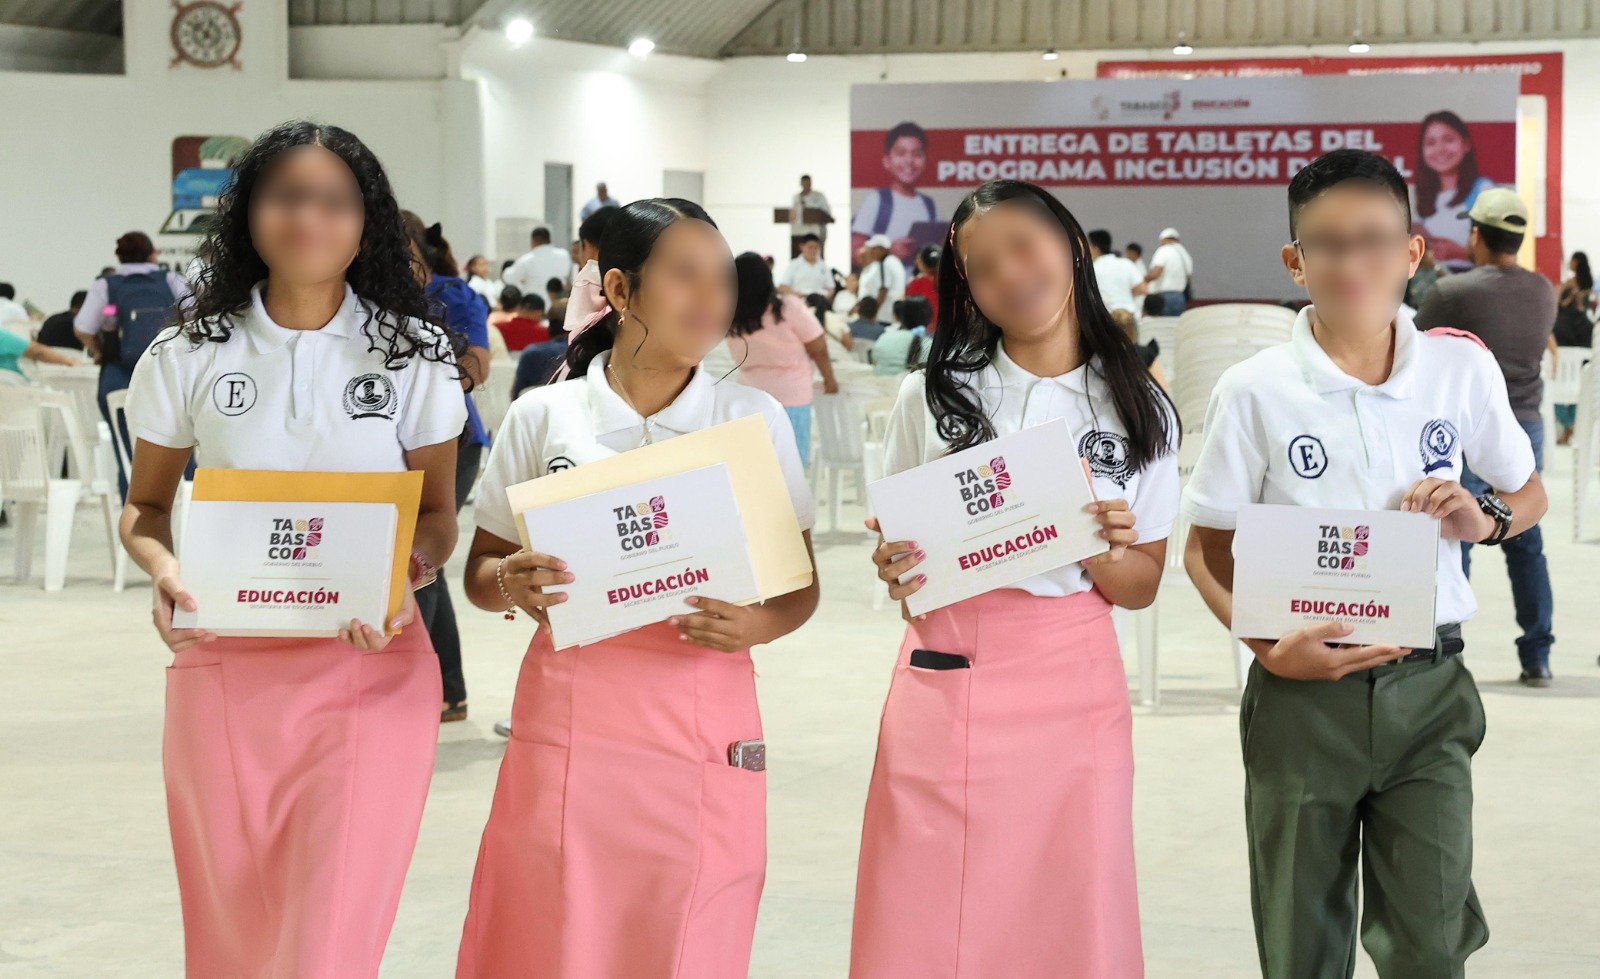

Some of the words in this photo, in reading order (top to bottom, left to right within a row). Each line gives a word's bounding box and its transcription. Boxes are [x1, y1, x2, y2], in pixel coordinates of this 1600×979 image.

[964, 133, 1101, 155] ENTREGA
[1108, 132, 1148, 154] DE
[1156, 129, 1313, 153] TABLETAS
[1320, 129, 1383, 151] DEL
[937, 158, 1107, 182] PROGRAMA
[1114, 151, 1279, 179] INCLUSIÓN
[224, 380, 246, 409] E
[1298, 444, 1318, 472] E
[954, 468, 979, 486] TA
[960, 479, 995, 502] BAS
[613, 504, 637, 521] TA
[966, 498, 990, 516] CO
[272, 518, 294, 531] TA
[616, 516, 652, 537] BAS
[1319, 525, 1340, 539] TA
[269, 532, 305, 546] BAS
[621, 535, 645, 551] CO
[958, 524, 1058, 571] EDUCACIÓN
[1318, 540, 1352, 555] BAS
[268, 546, 292, 560] CO
[1317, 555, 1340, 569] CO
[607, 567, 710, 605] EDUCACIÓN
[237, 587, 339, 604] EDUCACIÓN
[1291, 599, 1390, 618] EDUCACIÓN
